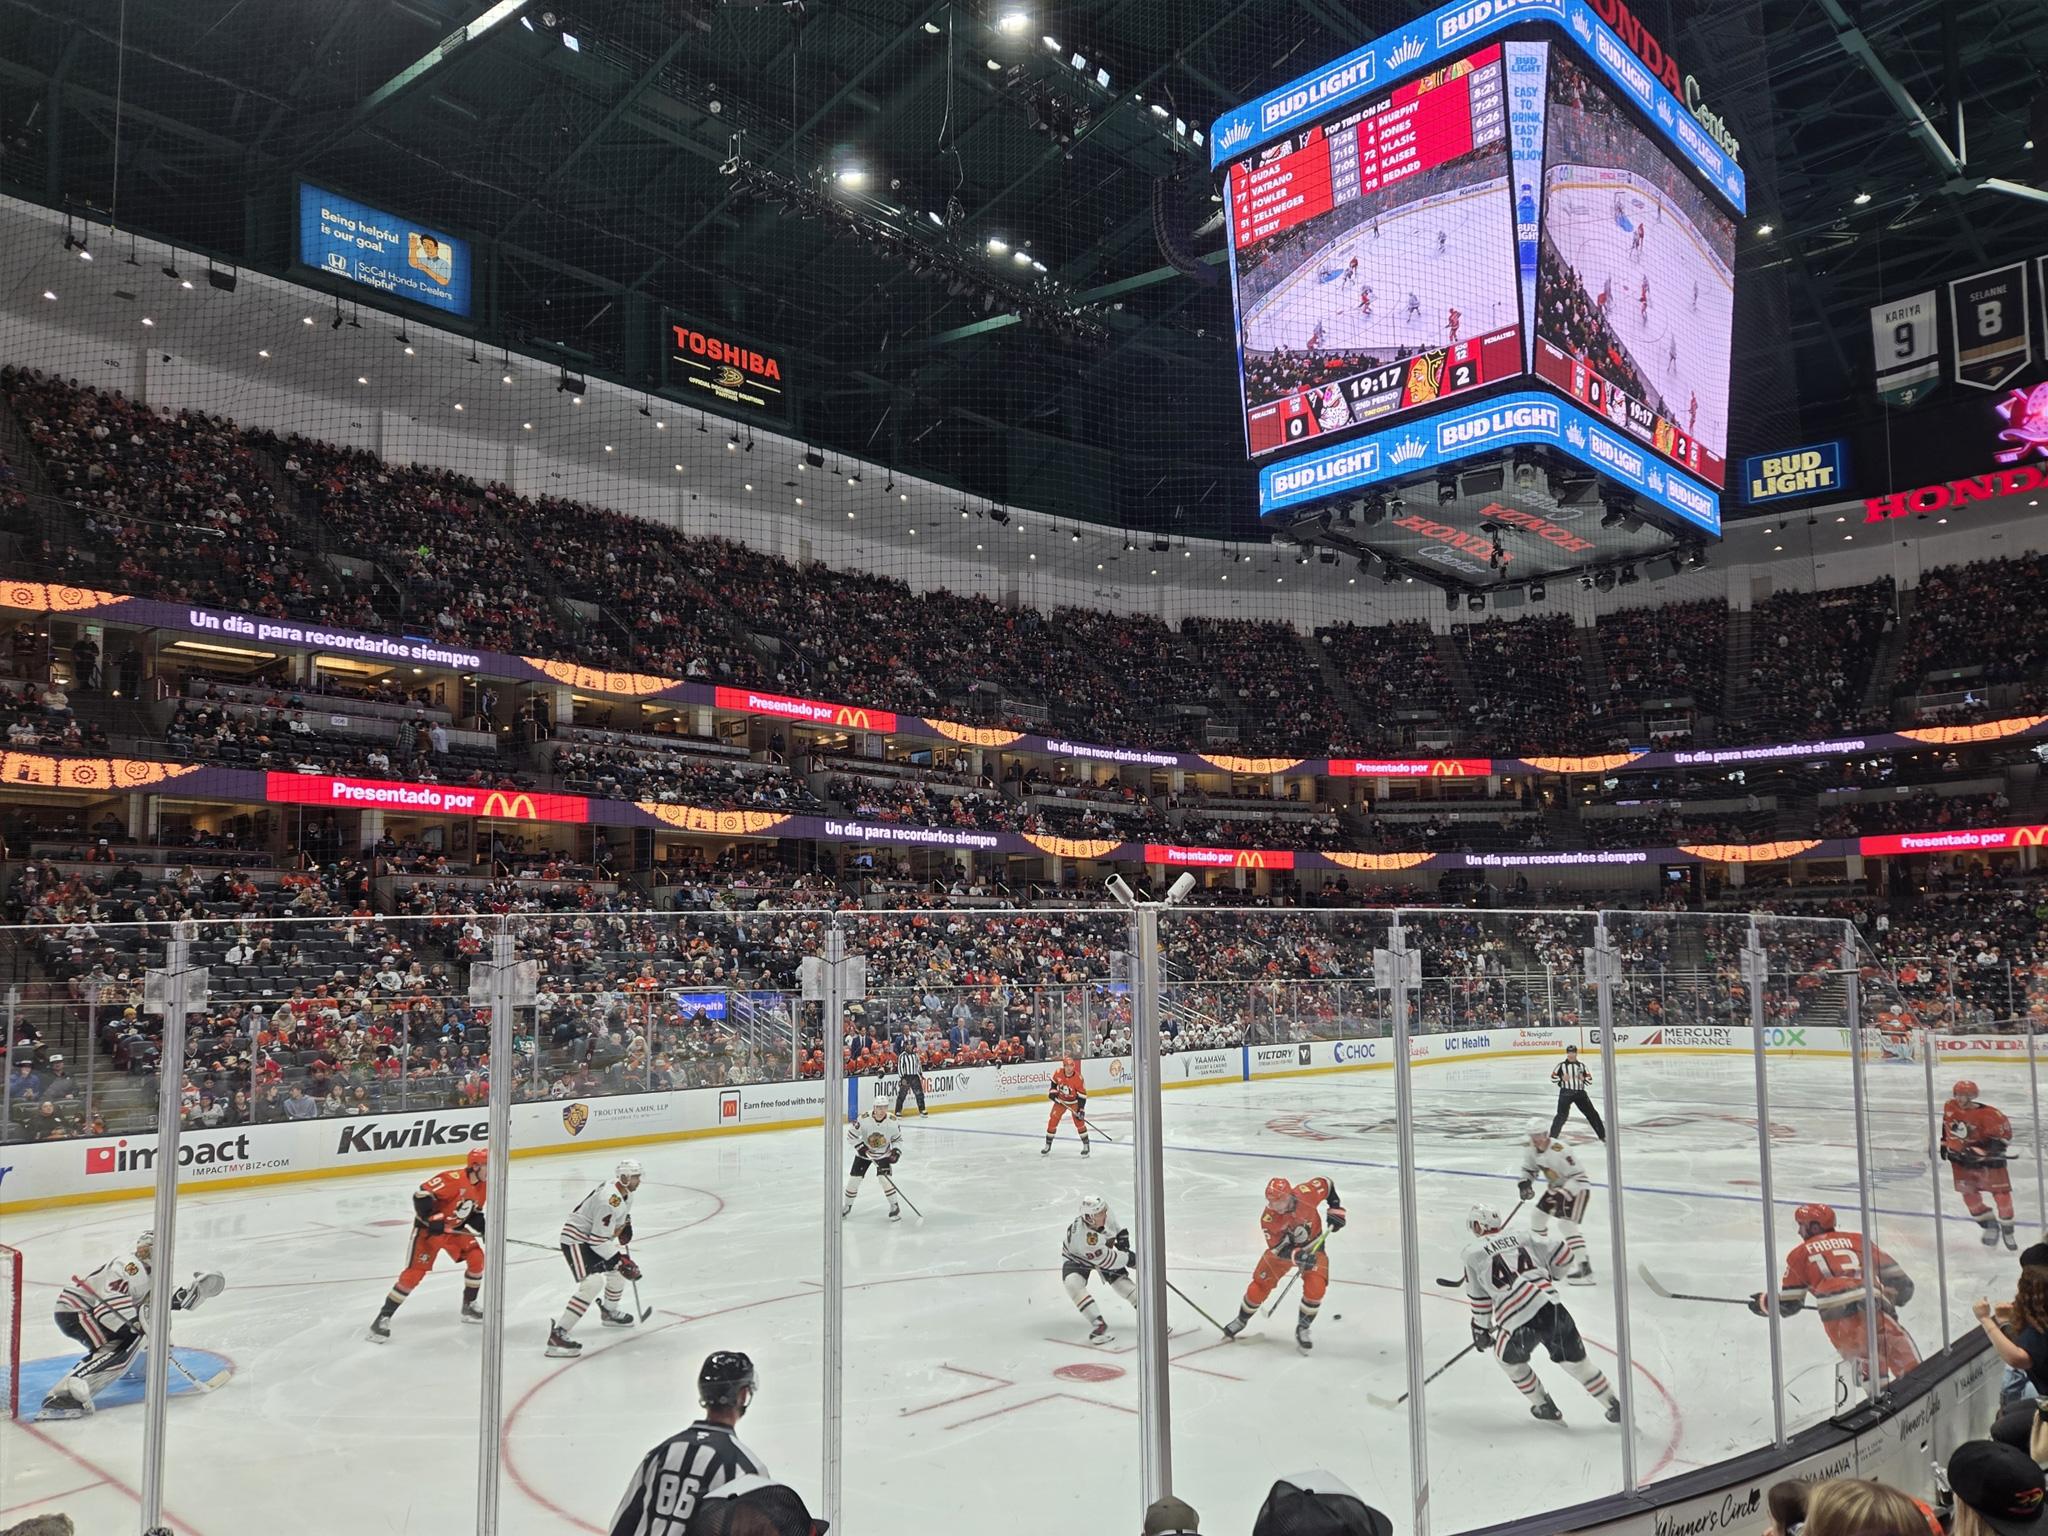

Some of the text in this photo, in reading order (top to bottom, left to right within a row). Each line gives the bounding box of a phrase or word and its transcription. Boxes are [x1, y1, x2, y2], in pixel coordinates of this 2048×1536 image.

[1442, 0, 1491, 40] BUD
[1473, 66, 1497, 83] 8:23
[1512, 57, 1541, 72] BUD LIGHT
[1599, 33, 1650, 99] BUD LIGHT
[1266, 61, 1370, 124] BUD LIGHT
[1514, 87, 1538, 97] EASY
[1520, 99, 1532, 110] TO
[1324, 99, 1391, 136] TOP TIME ON ICE
[1367, 121, 1374, 132] 5
[1378, 101, 1420, 127] MURPHY
[1368, 135, 1375, 144] 4
[1379, 119, 1412, 141] JONES
[1475, 95, 1498, 113] 7:29
[1512, 112, 1543, 123] DRINK,
[1685, 75, 1740, 162] Center
[1334, 111, 1500, 161] 7:10 72 VLASIC 6:26
[1514, 125, 1538, 136] EASY
[1520, 137, 1533, 148] TO
[1512, 150, 1543, 161] ENJOY
[1679, 118, 1721, 174] BUD LIGHT
[1241, 180, 1246, 188] 7
[1250, 164, 1281, 183] GUDAS
[1335, 159, 1356, 174] 7:05
[1365, 163, 1377, 175] 44
[1381, 147, 1417, 168] KAISER
[1236, 160, 1421, 203] 77 VATRANO 6:51 98 BEDARD
[1240, 195, 1304, 228] 51 ZELLWEGER
[1242, 187, 1358, 213] 4 FOWLER 6:17
[321, 208, 400, 244] Being helpful
[321, 223, 385, 254] is our goal.
[1241, 220, 1280, 242] 19 TERRY
[321, 262, 453, 300] HONDA SoCal Honda Dealers
[1884, 304, 1922, 324] KARIYA
[1977, 300, 2003, 336] 8
[673, 325, 780, 380] TOSHIBA
[1894, 322, 1914, 358] 9
[1350, 366, 1402, 398] 19:17
[1456, 367, 1470, 386] 2
[1371, 391, 1398, 405] PERIOD
[1591, 382, 1599, 400] 0
[1290, 418, 1303, 436] 0
[1442, 408, 1557, 446] BUD LIGHT
[1630, 401, 1653, 427] 19:17
[1591, 434, 1642, 477] BUD LIGHT
[1678, 438, 1686, 456] 2
[1275, 450, 1374, 494] BUD LIGHT
[1763, 451, 1822, 477] BUD
[1753, 467, 1832, 498] LIGHT
[1669, 480, 1712, 516] BUD LIGHT
[190, 610, 480, 667] Un día para recordarlos siempre
[749, 695, 832, 719] Presentado por
[1047, 740, 1178, 766] Un día para recordarlos siempre
[1675, 739, 1865, 764] Un día para recordarlos siempre
[1355, 762, 1428, 774] Presentado por
[332, 782, 474, 809] Presentado por
[825, 821, 997, 848] Un día para recordarlos siempre
[1901, 833, 2006, 849] Presentado por
[1168, 849, 1233, 864] Presentado por
[1466, 851, 1646, 867] Un día para recordarlos siempre
[1444, 1038, 1459, 1050] UCI
[1462, 1035, 1490, 1049] Health
[1665, 1028, 1731, 1038] MERCURY
[1665, 1038, 1732, 1046] INSURANCE
[1763, 1029, 1807, 1047] COX
[1936, 1039, 2025, 1050] HONDA
[1257, 1049, 1294, 1060] VICTORY
[1346, 1044, 1376, 1059] CHOC
[1001, 1071, 1051, 1085] easterseals
[594, 1107, 634, 1117] TROUTMAN
[635, 1104, 655, 1113] AMIN,
[657, 1103, 669, 1111] LLP
[744, 1101, 760, 1110] Earn
[761, 1099, 774, 1108] free
[775, 1098, 790, 1107] food
[791, 1097, 806, 1106] with
[336, 1119, 490, 1154] Kwikse
[428, 1176, 445, 1192] 91
[602, 1213, 612, 1227] 4
[1483, 1236, 1519, 1255] KAISER
[1491, 1246, 1537, 1290] 44
[1808, 1249, 1862, 1279] 13
[656, 1473, 700, 1519] 86
[1655, 1488, 1761, 1536] Winner's Circle
